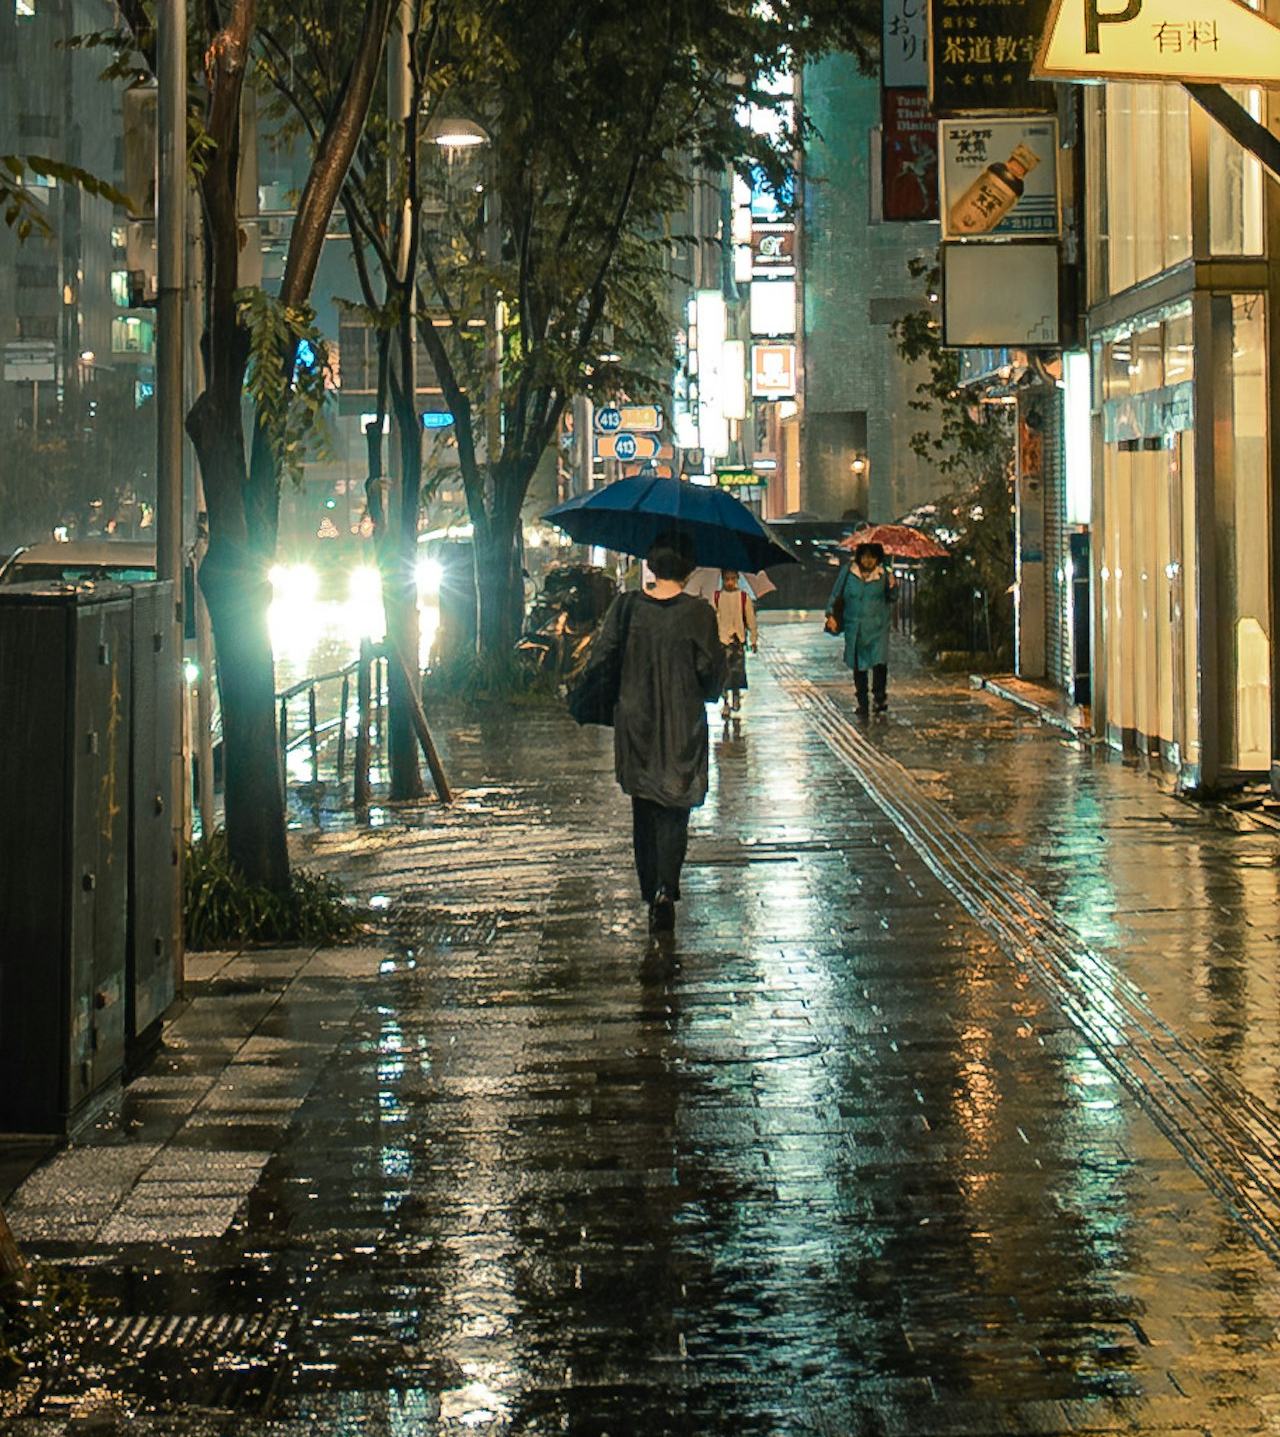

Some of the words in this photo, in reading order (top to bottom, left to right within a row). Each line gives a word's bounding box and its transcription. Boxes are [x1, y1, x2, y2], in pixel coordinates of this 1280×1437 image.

[942, 34, 1041, 64] 茶道教室
[1151, 18, 1222, 53] 有料
[600, 411, 620, 427] 413
